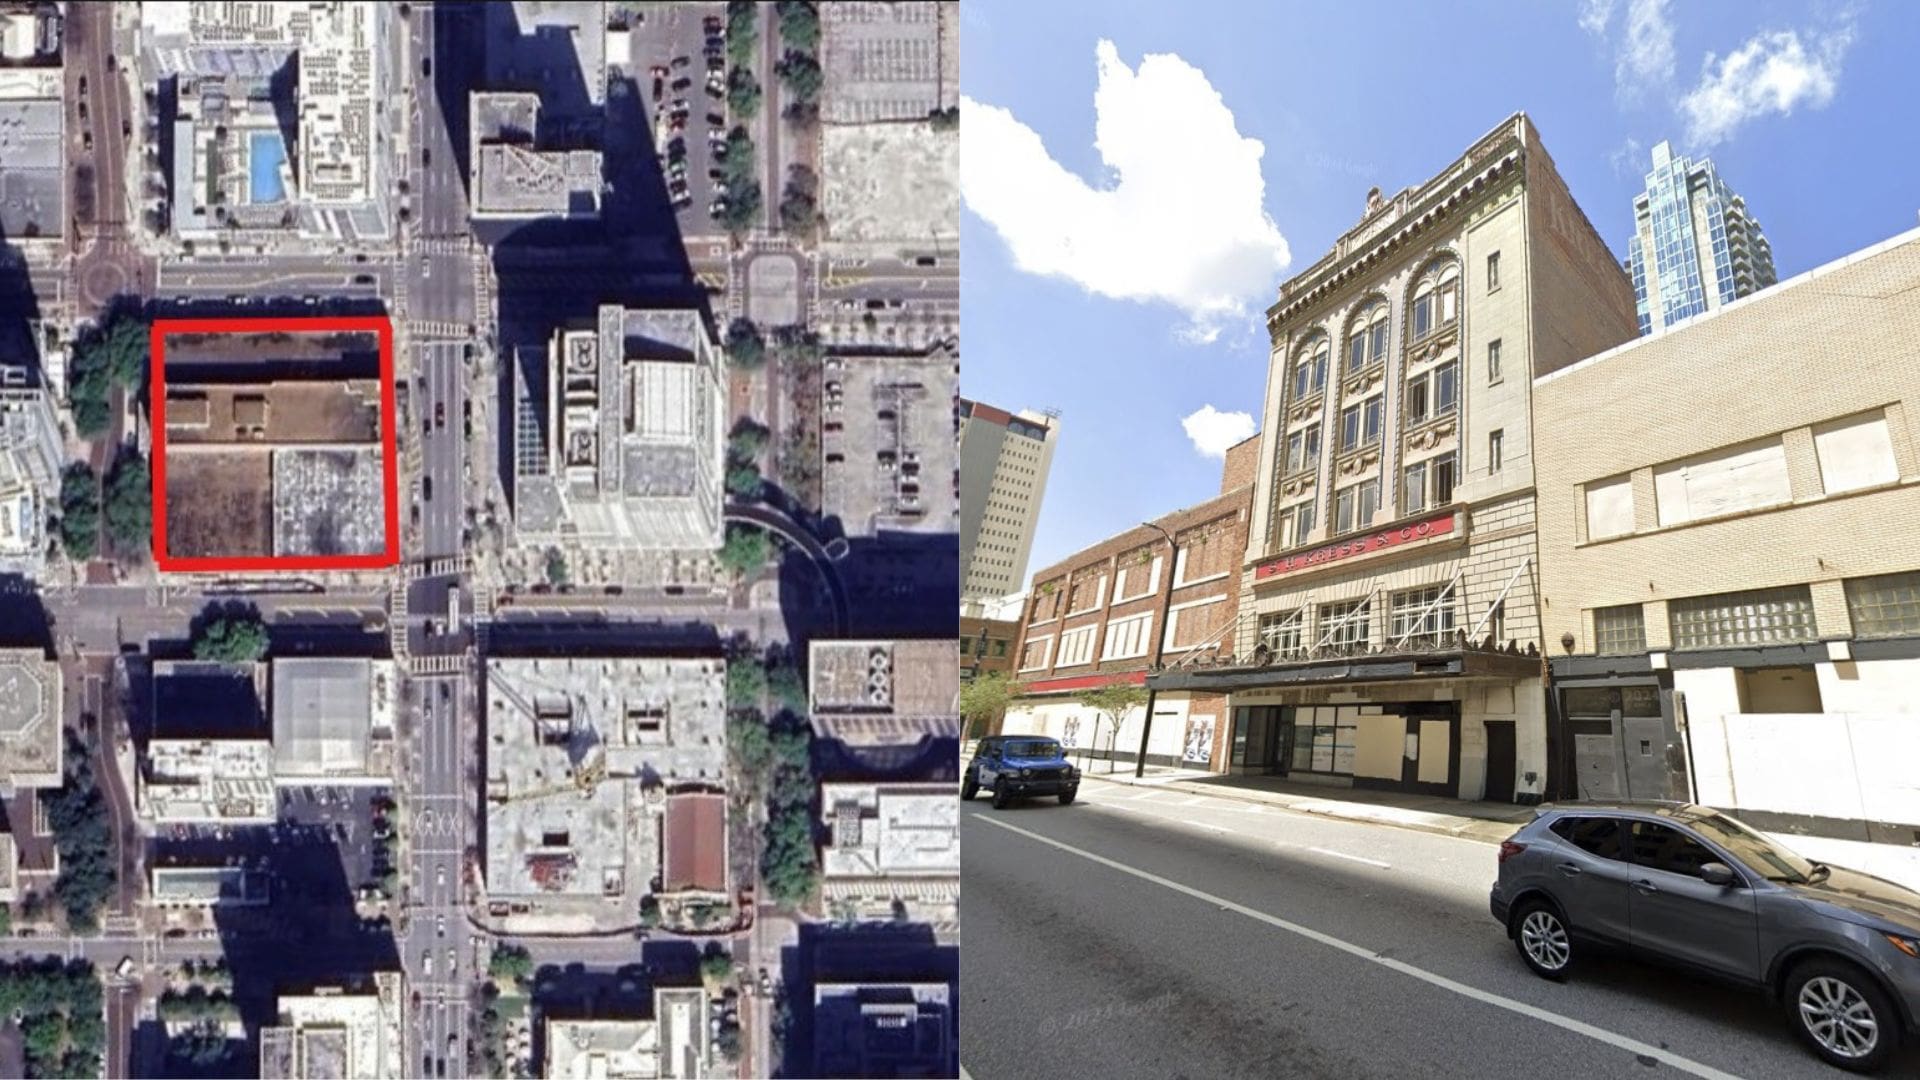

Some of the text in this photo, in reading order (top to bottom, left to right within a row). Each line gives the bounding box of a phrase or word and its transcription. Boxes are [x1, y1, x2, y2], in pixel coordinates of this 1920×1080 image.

[1304, 540, 1366, 563] KRESS
[1376, 533, 1389, 546] &
[1400, 522, 1435, 541] CO.
